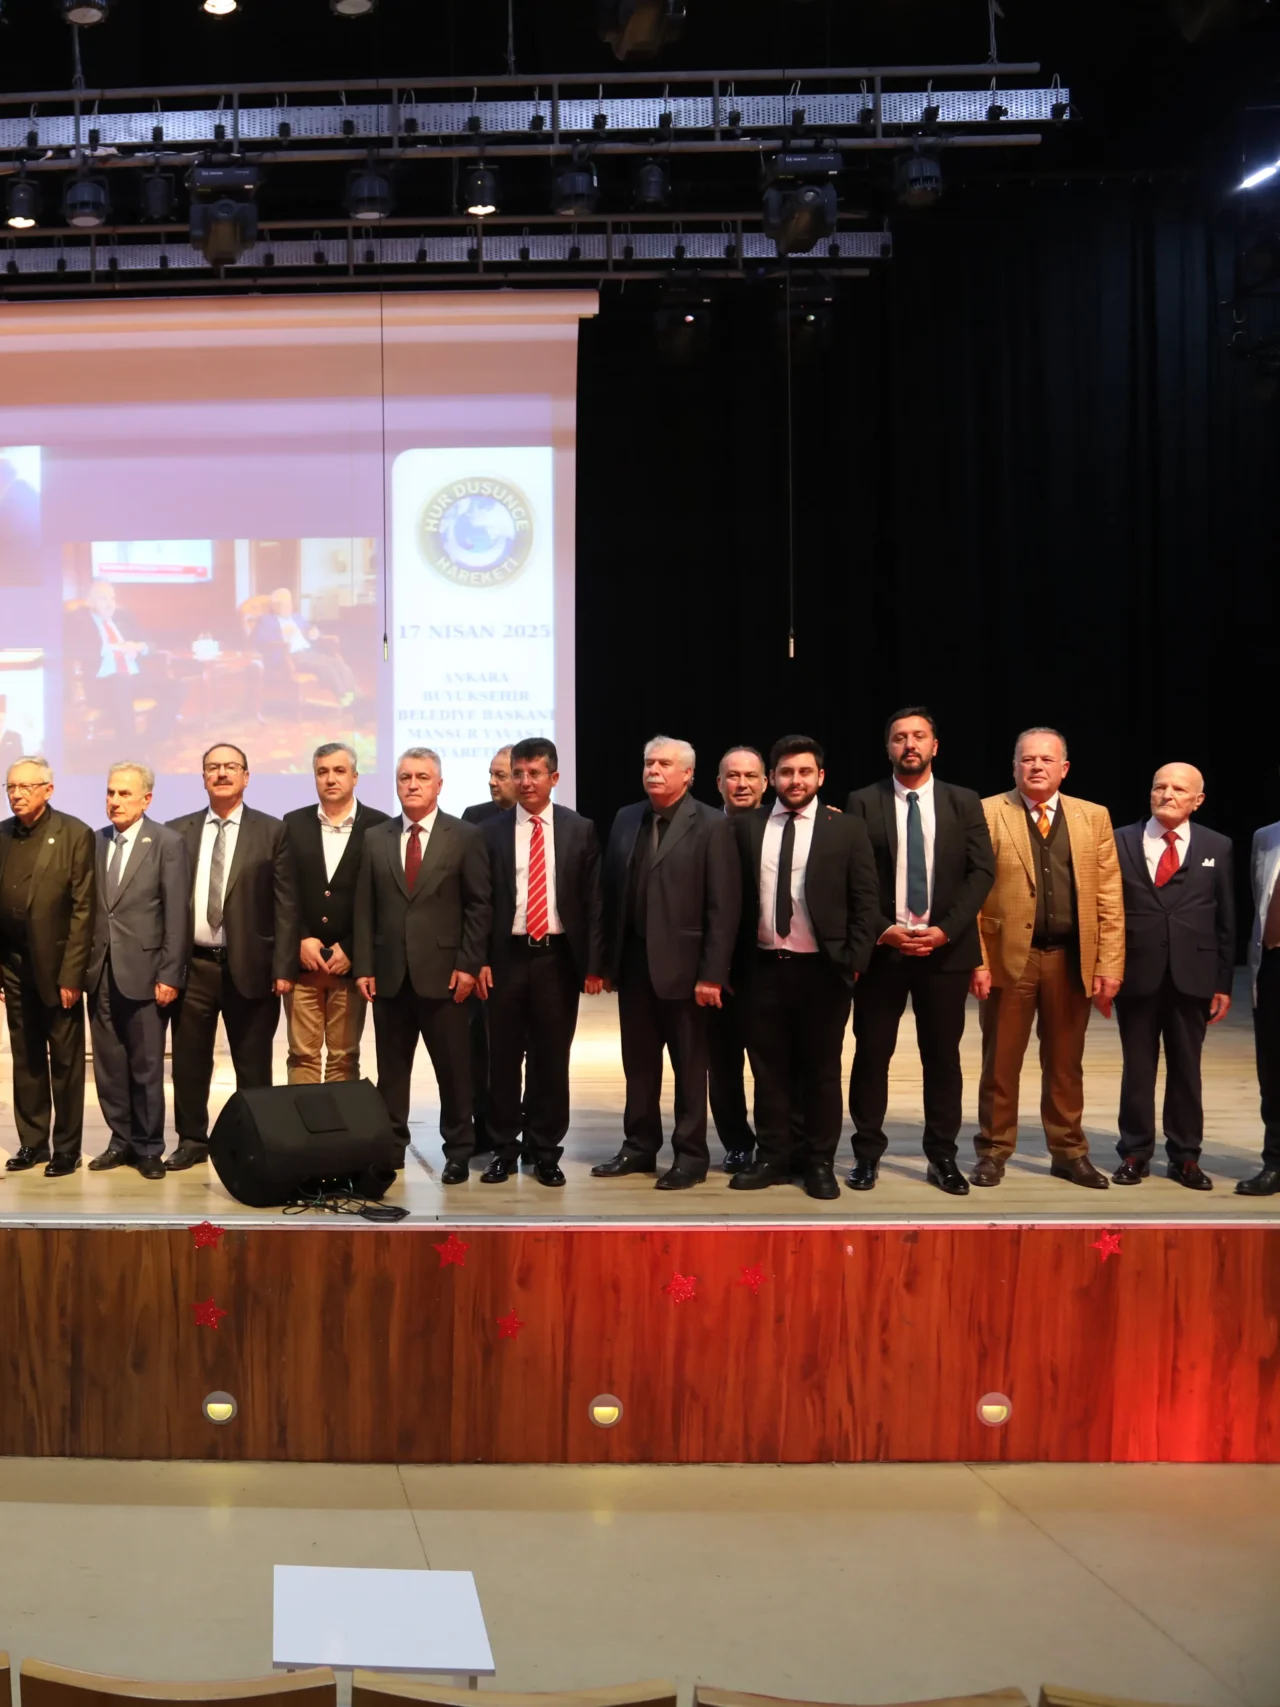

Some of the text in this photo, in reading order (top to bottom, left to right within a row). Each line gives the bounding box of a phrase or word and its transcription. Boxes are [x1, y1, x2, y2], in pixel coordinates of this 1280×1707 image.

[399, 624, 421, 639] 17
[502, 624, 551, 639] 2025
[443, 671, 510, 684] ANKARA
